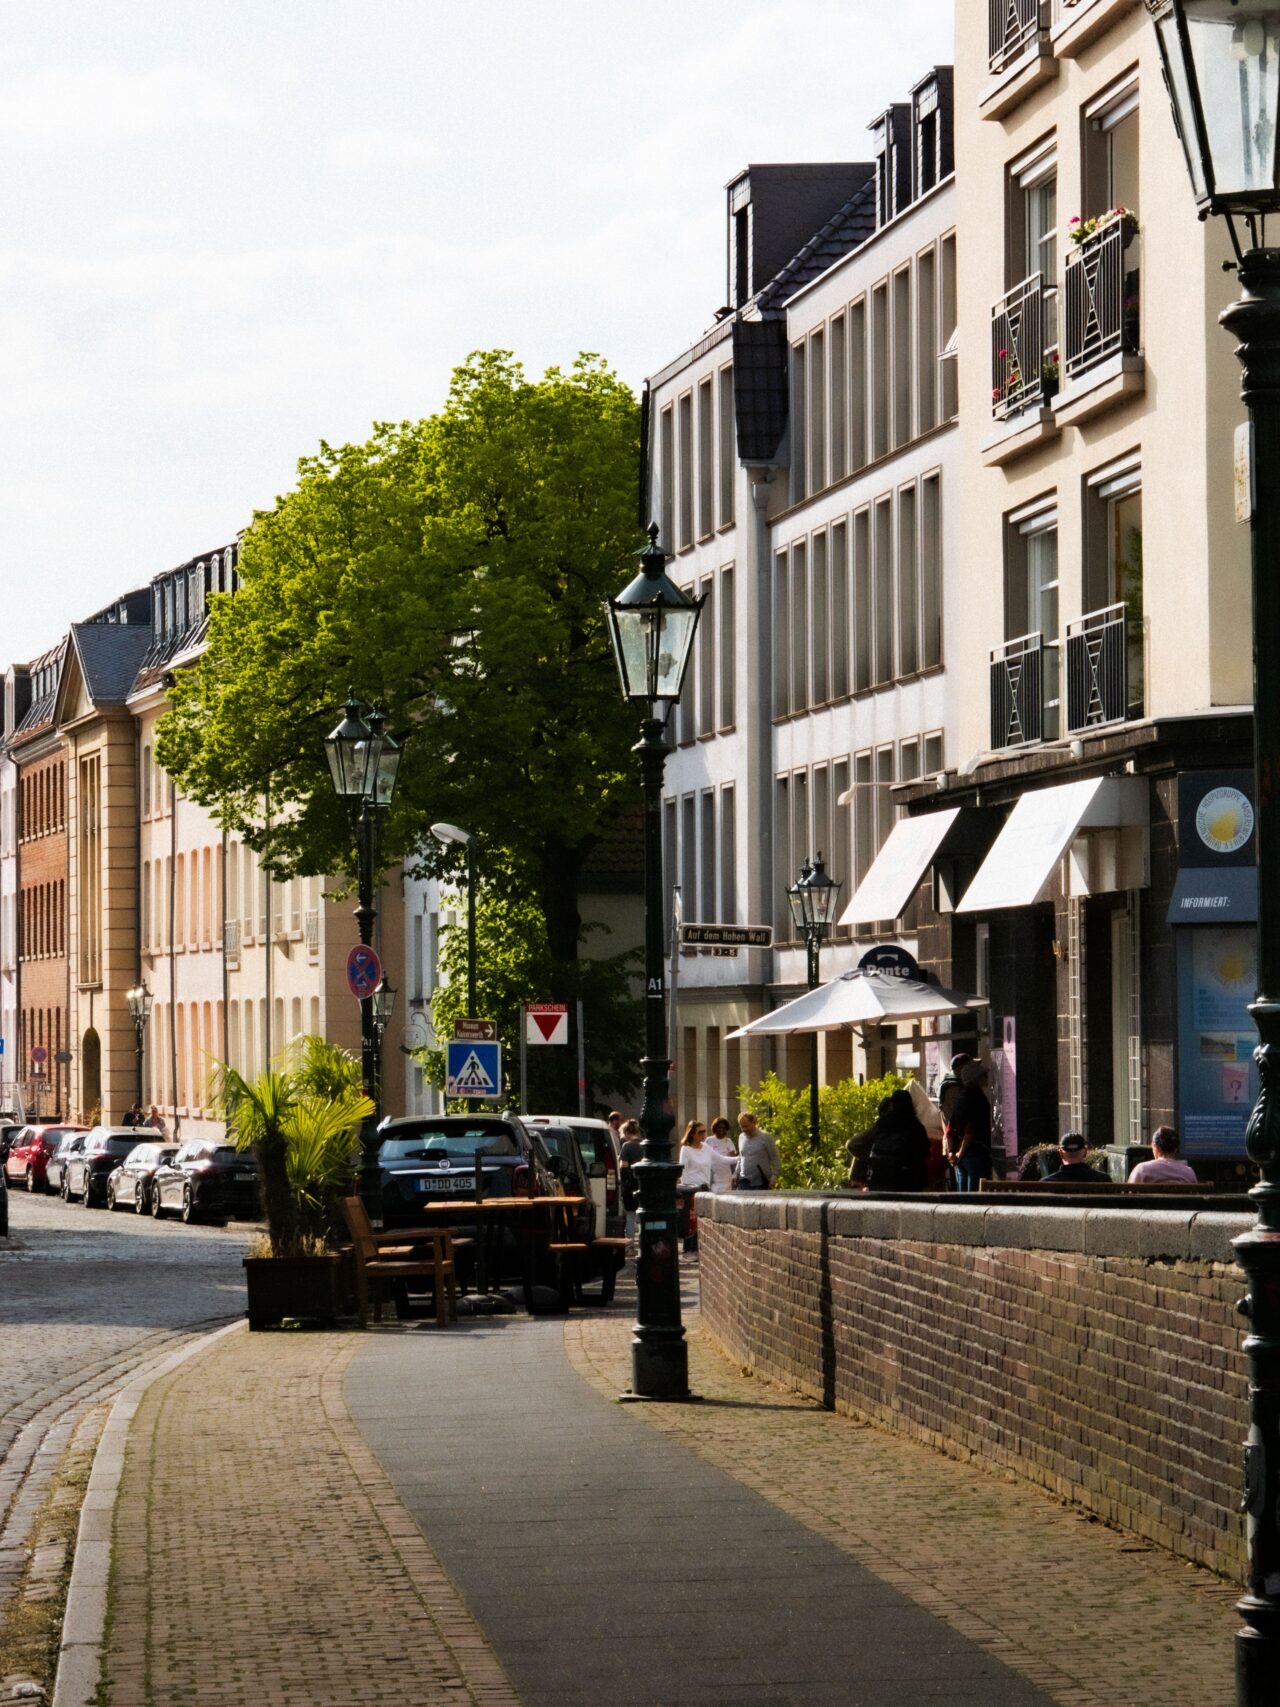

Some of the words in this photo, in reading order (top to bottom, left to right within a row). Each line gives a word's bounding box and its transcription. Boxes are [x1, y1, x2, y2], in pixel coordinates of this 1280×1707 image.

[1181, 896, 1231, 909] INFORMIERT:
[687, 930, 700, 940] Auf
[704, 930, 719, 940] dem
[722, 930, 745, 941] Hohen
[749, 932, 766, 943] Wall
[648, 978, 662, 990] A1
[528, 1003, 566, 1011] PARKSCHEIN
